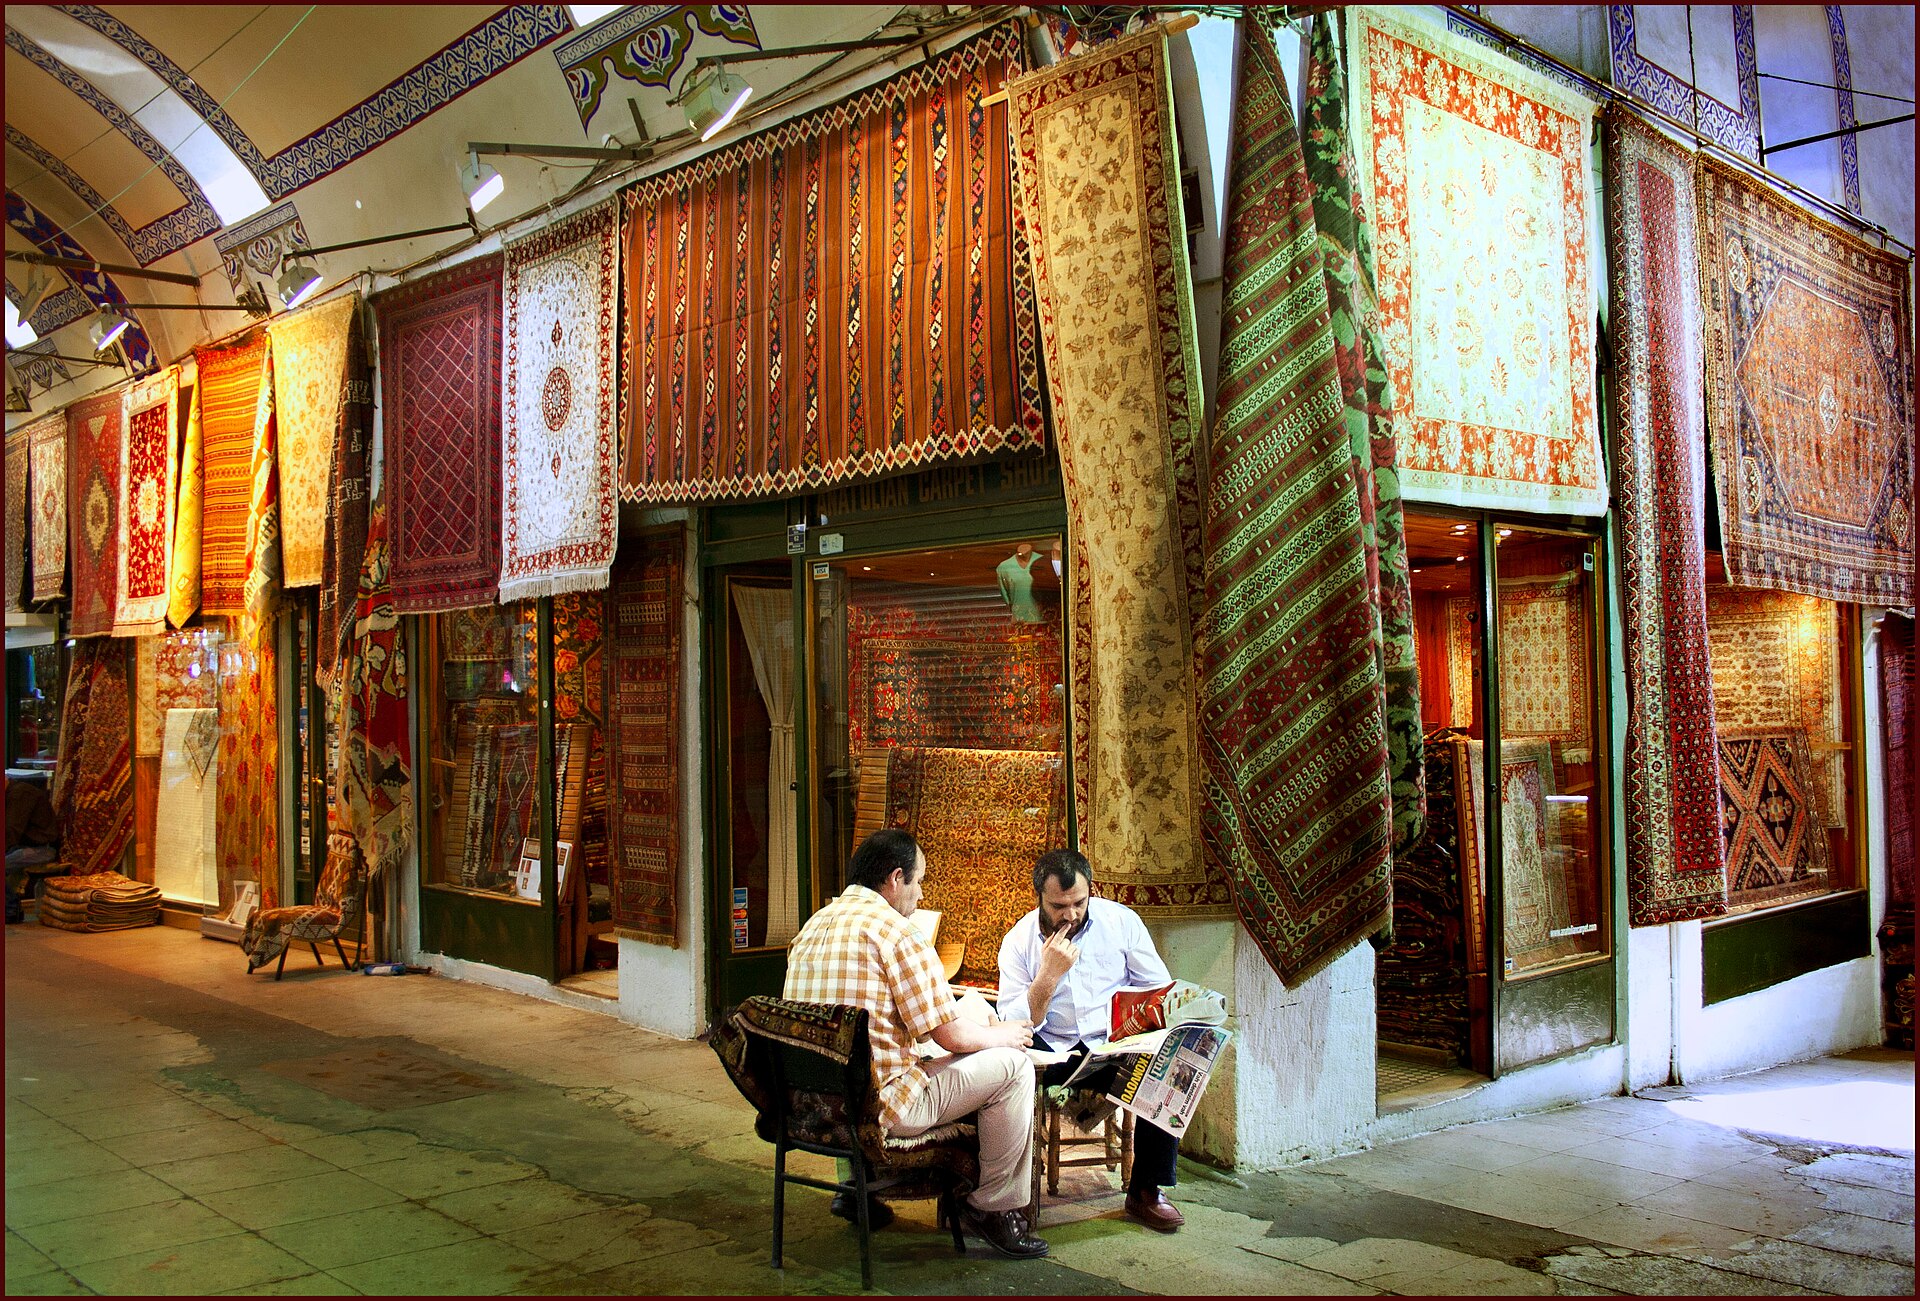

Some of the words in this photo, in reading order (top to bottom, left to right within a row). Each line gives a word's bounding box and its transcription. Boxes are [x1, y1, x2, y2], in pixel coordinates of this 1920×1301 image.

[918, 465, 985, 502] CARPET
[1000, 457, 1056, 491] SHOP
[1120, 1057, 1149, 1103] KONVOYU
